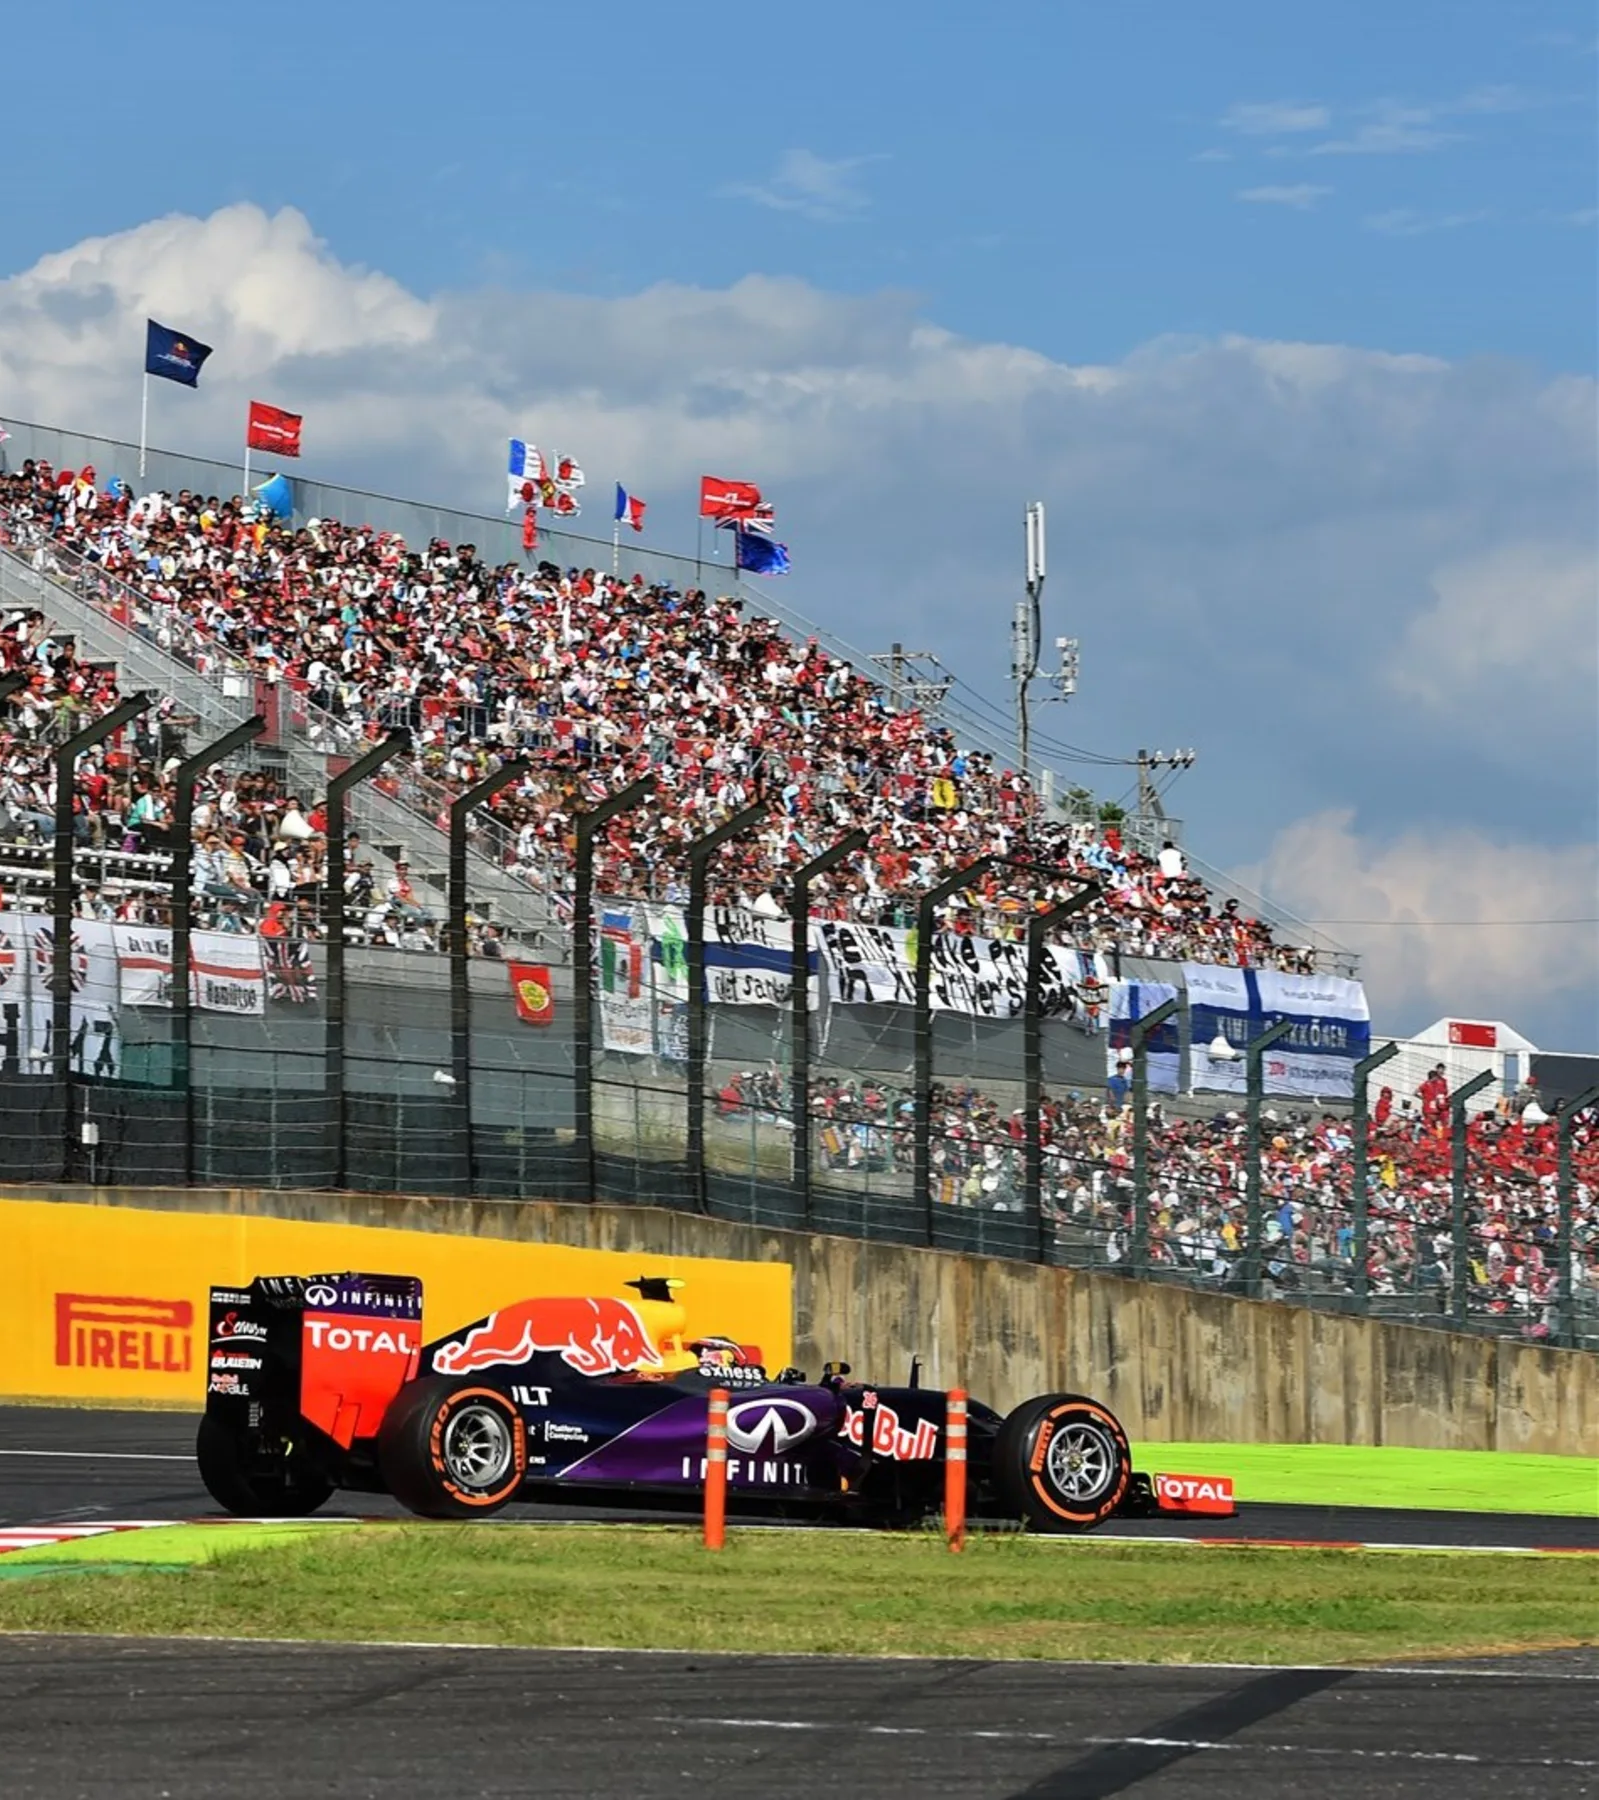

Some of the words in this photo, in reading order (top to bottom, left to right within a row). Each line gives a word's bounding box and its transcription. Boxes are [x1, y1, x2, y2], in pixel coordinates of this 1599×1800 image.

[55, 1292, 193, 1374] PIRELLI
[304, 1320, 418, 1355] TOTAL
[872, 1403, 939, 1461] Bull
[682, 1456, 809, 1485] IFINIT
[1156, 1476, 1233, 1500] TOTAL
